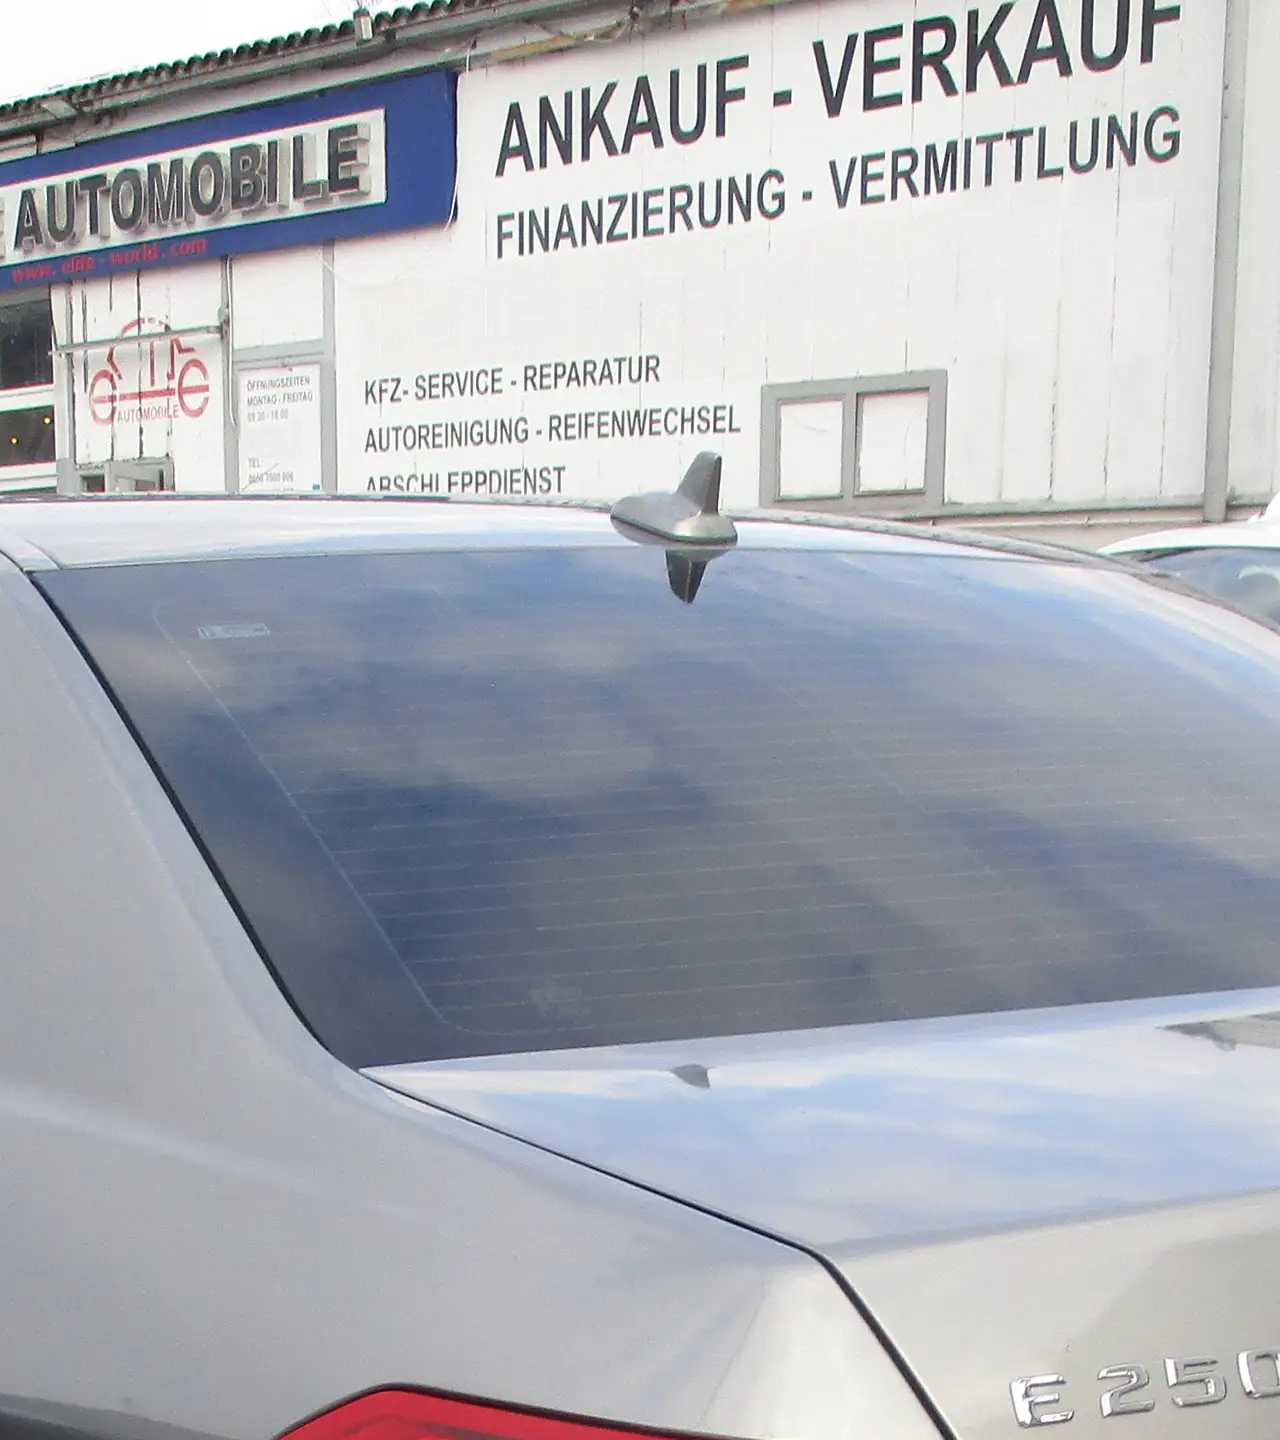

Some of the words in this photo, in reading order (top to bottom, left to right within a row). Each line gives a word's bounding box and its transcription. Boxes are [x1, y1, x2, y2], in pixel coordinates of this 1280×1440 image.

[495, 55, 750, 178] ANKAUF
[813, 0, 1182, 118] VERKAUF
[13, 122, 370, 250] AUTOMOBILE
[496, 168, 787, 259] FINANZIERUNG
[829, 105, 1182, 209] VERMITTLUNG
[524, 354, 661, 392] REPARATUR
[364, 416, 529, 454] AUTOREINIGUNG
[548, 405, 741, 442] REIFENWECHSEL
[1009, 1373, 1074, 1428] E
